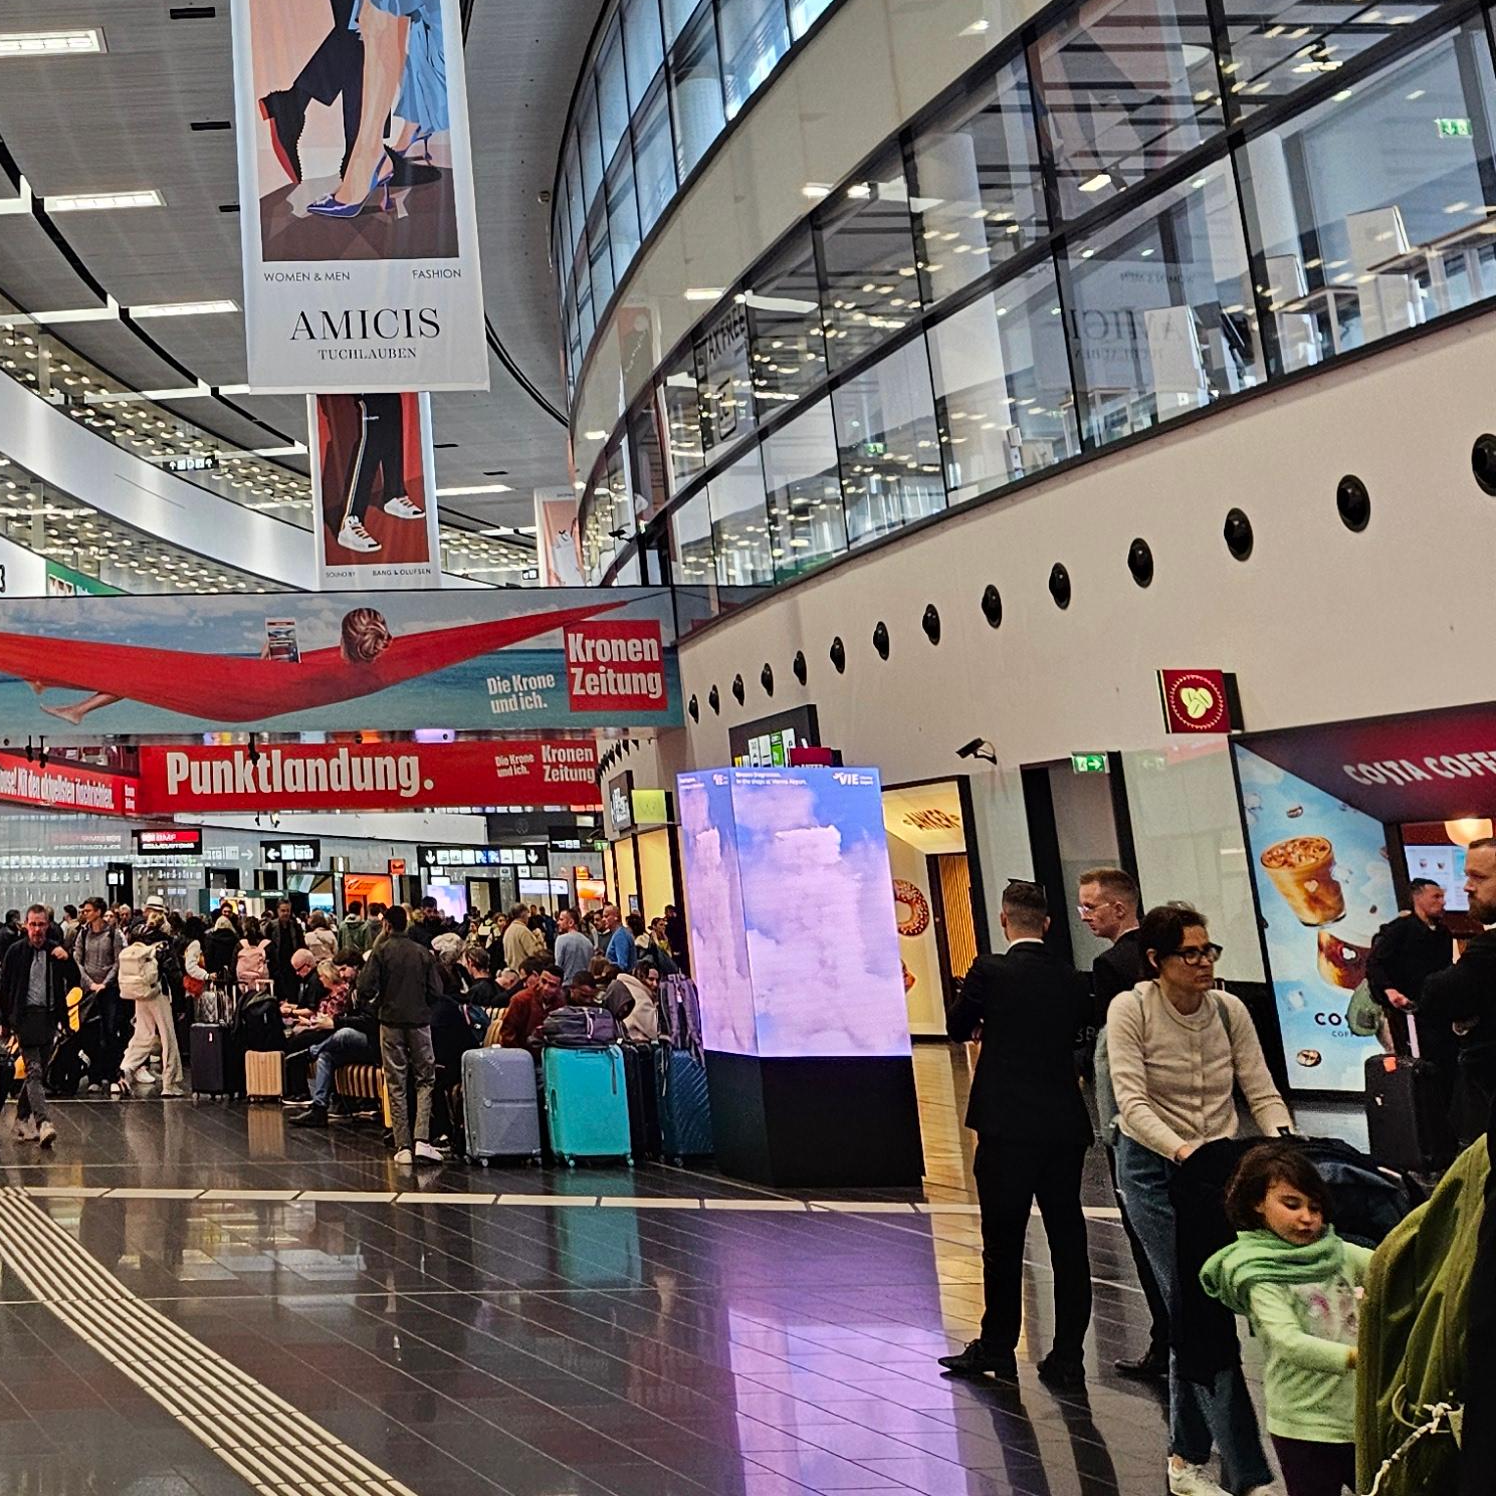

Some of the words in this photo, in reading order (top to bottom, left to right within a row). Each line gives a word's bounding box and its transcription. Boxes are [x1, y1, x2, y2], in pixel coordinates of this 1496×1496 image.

[264, 272, 310, 281] WOMEN
[314, 272, 322, 281] &
[324, 272, 350, 281] MEN
[412, 269, 461, 279] FASHION
[290, 307, 441, 341] AMICIS
[318, 348, 416, 361] TUCHLAUBEN
[399, 568, 431, 576] OLUFSEN
[568, 633, 659, 662] Kronen
[487, 676, 511, 695] Die
[512, 674, 555, 693] Krone
[571, 665, 662, 699] Zeitung
[490, 694, 520, 714] und
[519, 691, 548, 711] ich.
[509, 753, 535, 765] Krone
[541, 745, 594, 763] Kronen
[166, 747, 434, 798] Punktlandung.
[497, 768, 513, 777] und
[513, 765, 530, 775] ich.
[543, 764, 596, 784] Zeitung
[1342, 759, 1433, 786] COSTA
